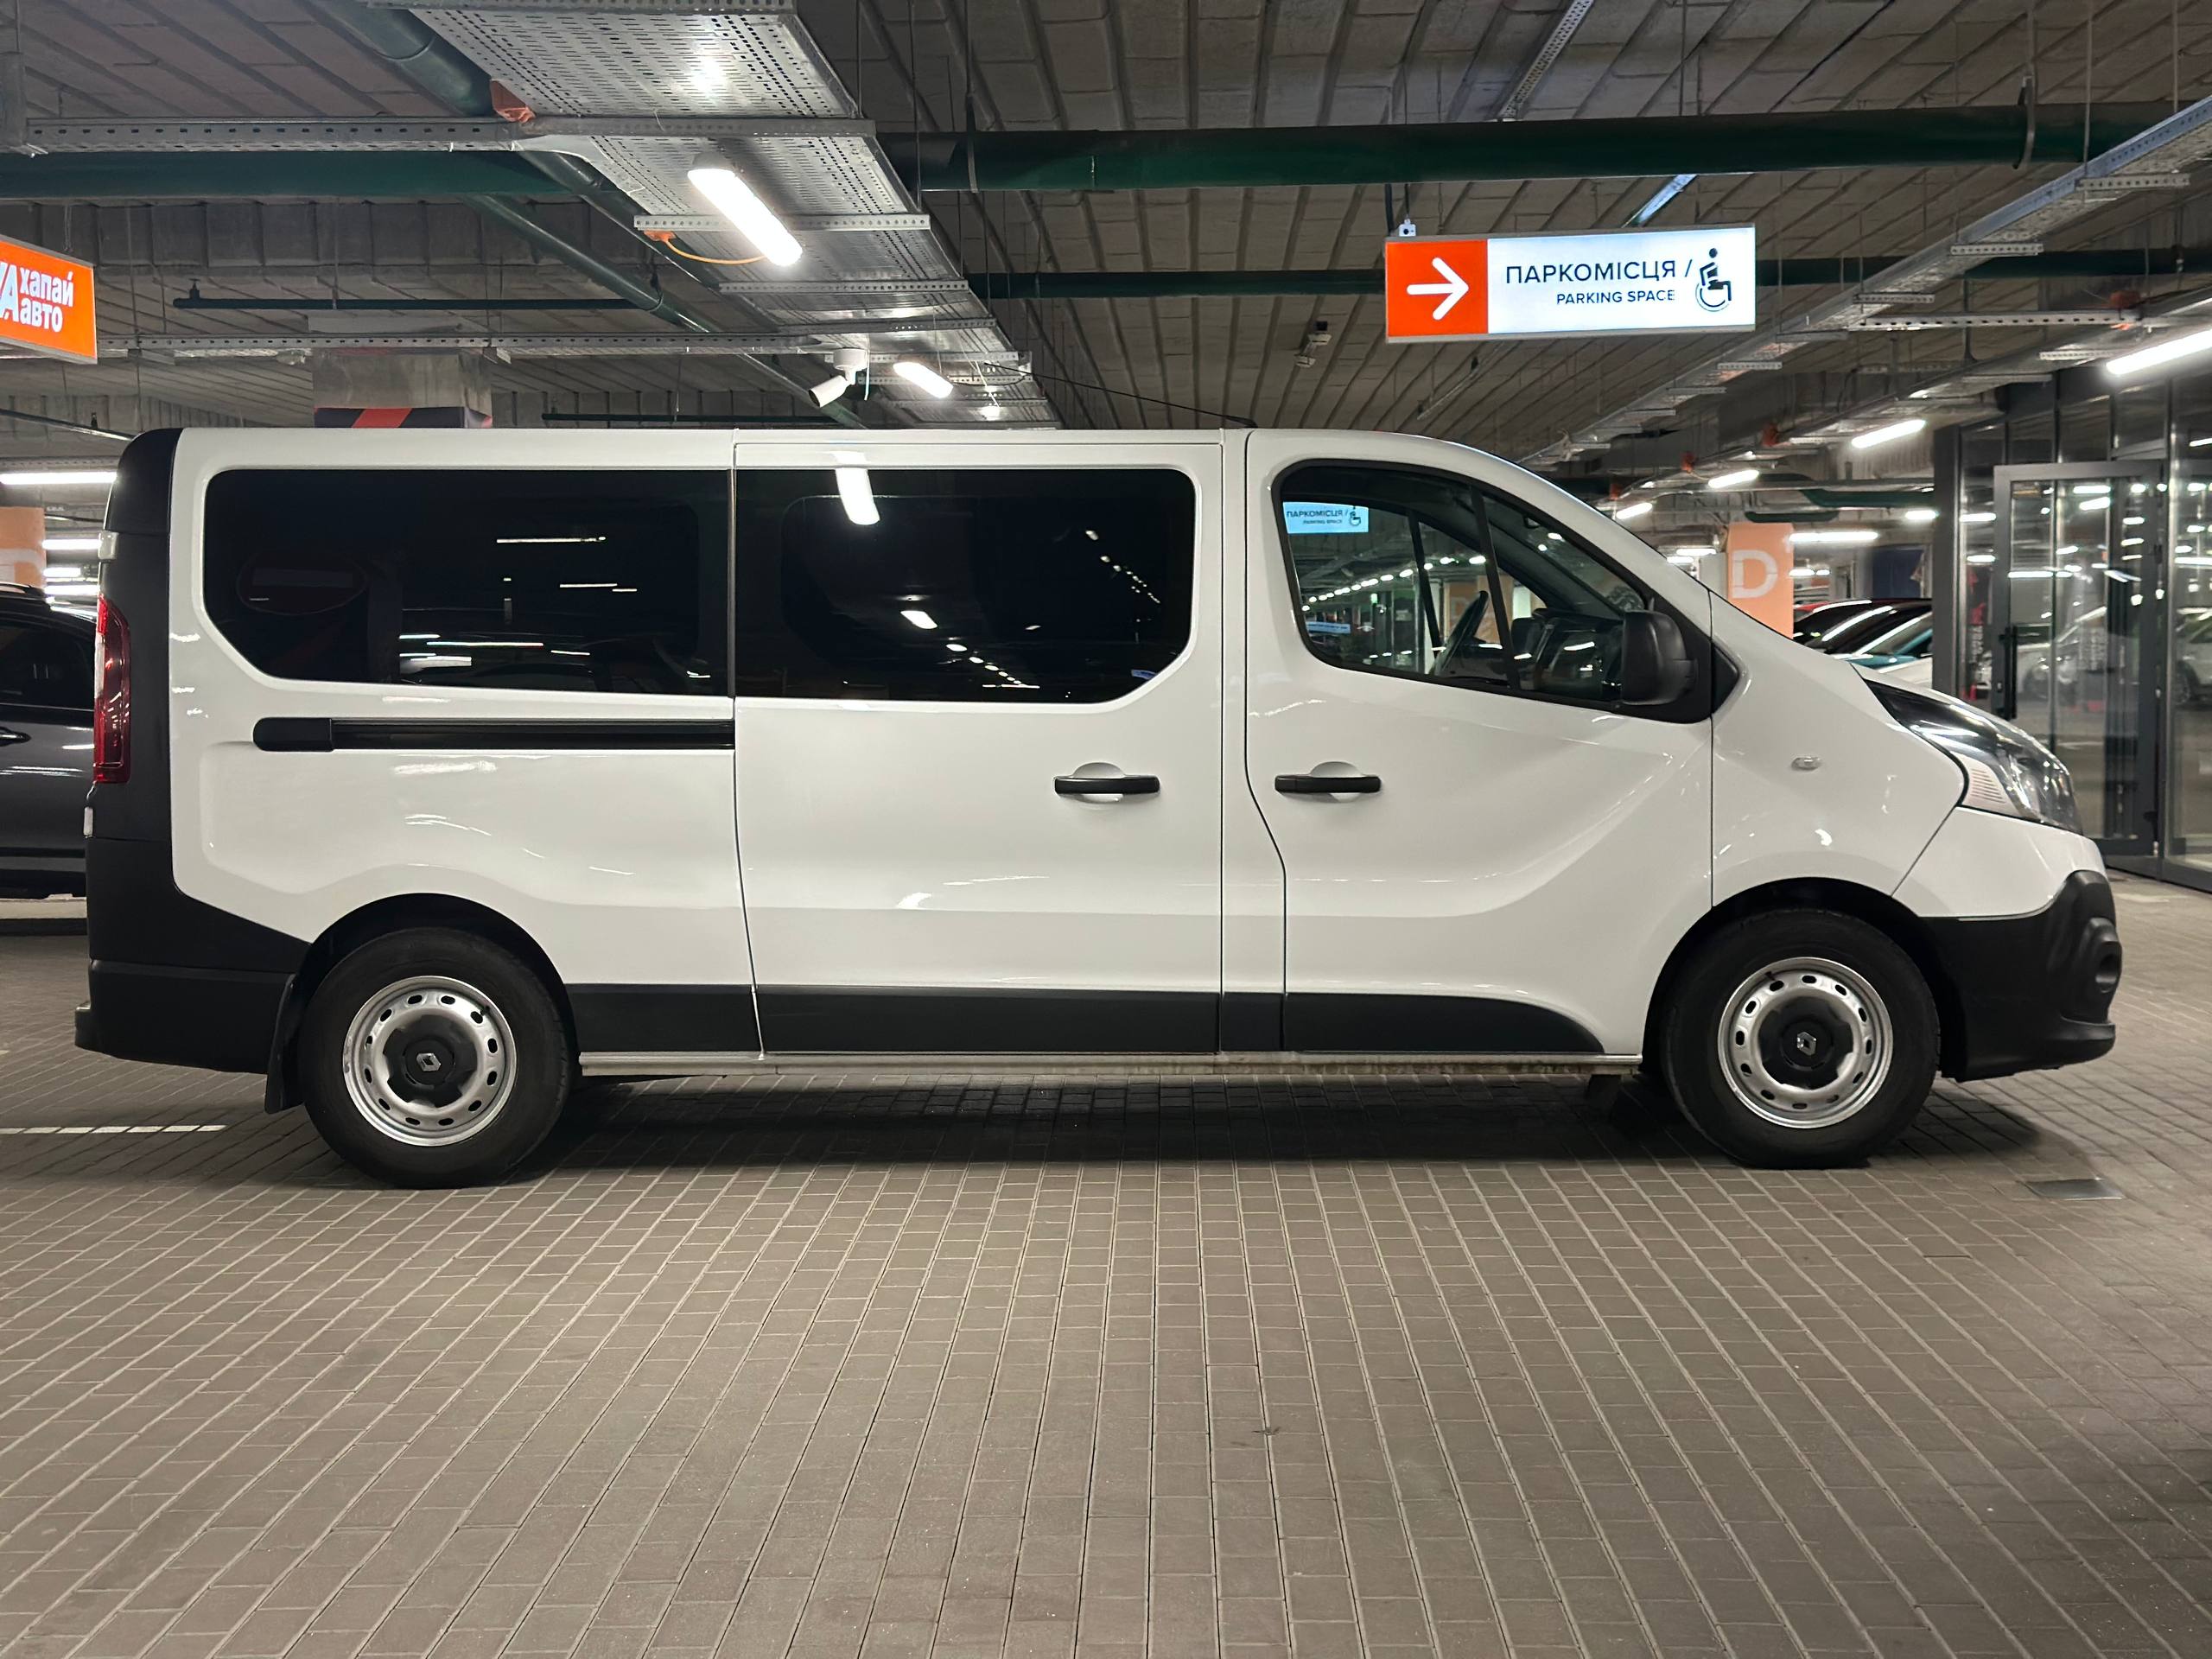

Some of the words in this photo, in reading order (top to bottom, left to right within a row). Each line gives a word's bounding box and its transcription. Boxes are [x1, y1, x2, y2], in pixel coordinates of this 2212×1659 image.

[20, 267, 74, 308] хапай
[1506, 260, 1676, 283] ПАРКОМІСЦЯ
[1557, 291, 1623, 304] PARKING
[1627, 289, 1675, 302] SPACE
[20, 297, 63, 333] авто
[1732, 550, 1778, 599] D
